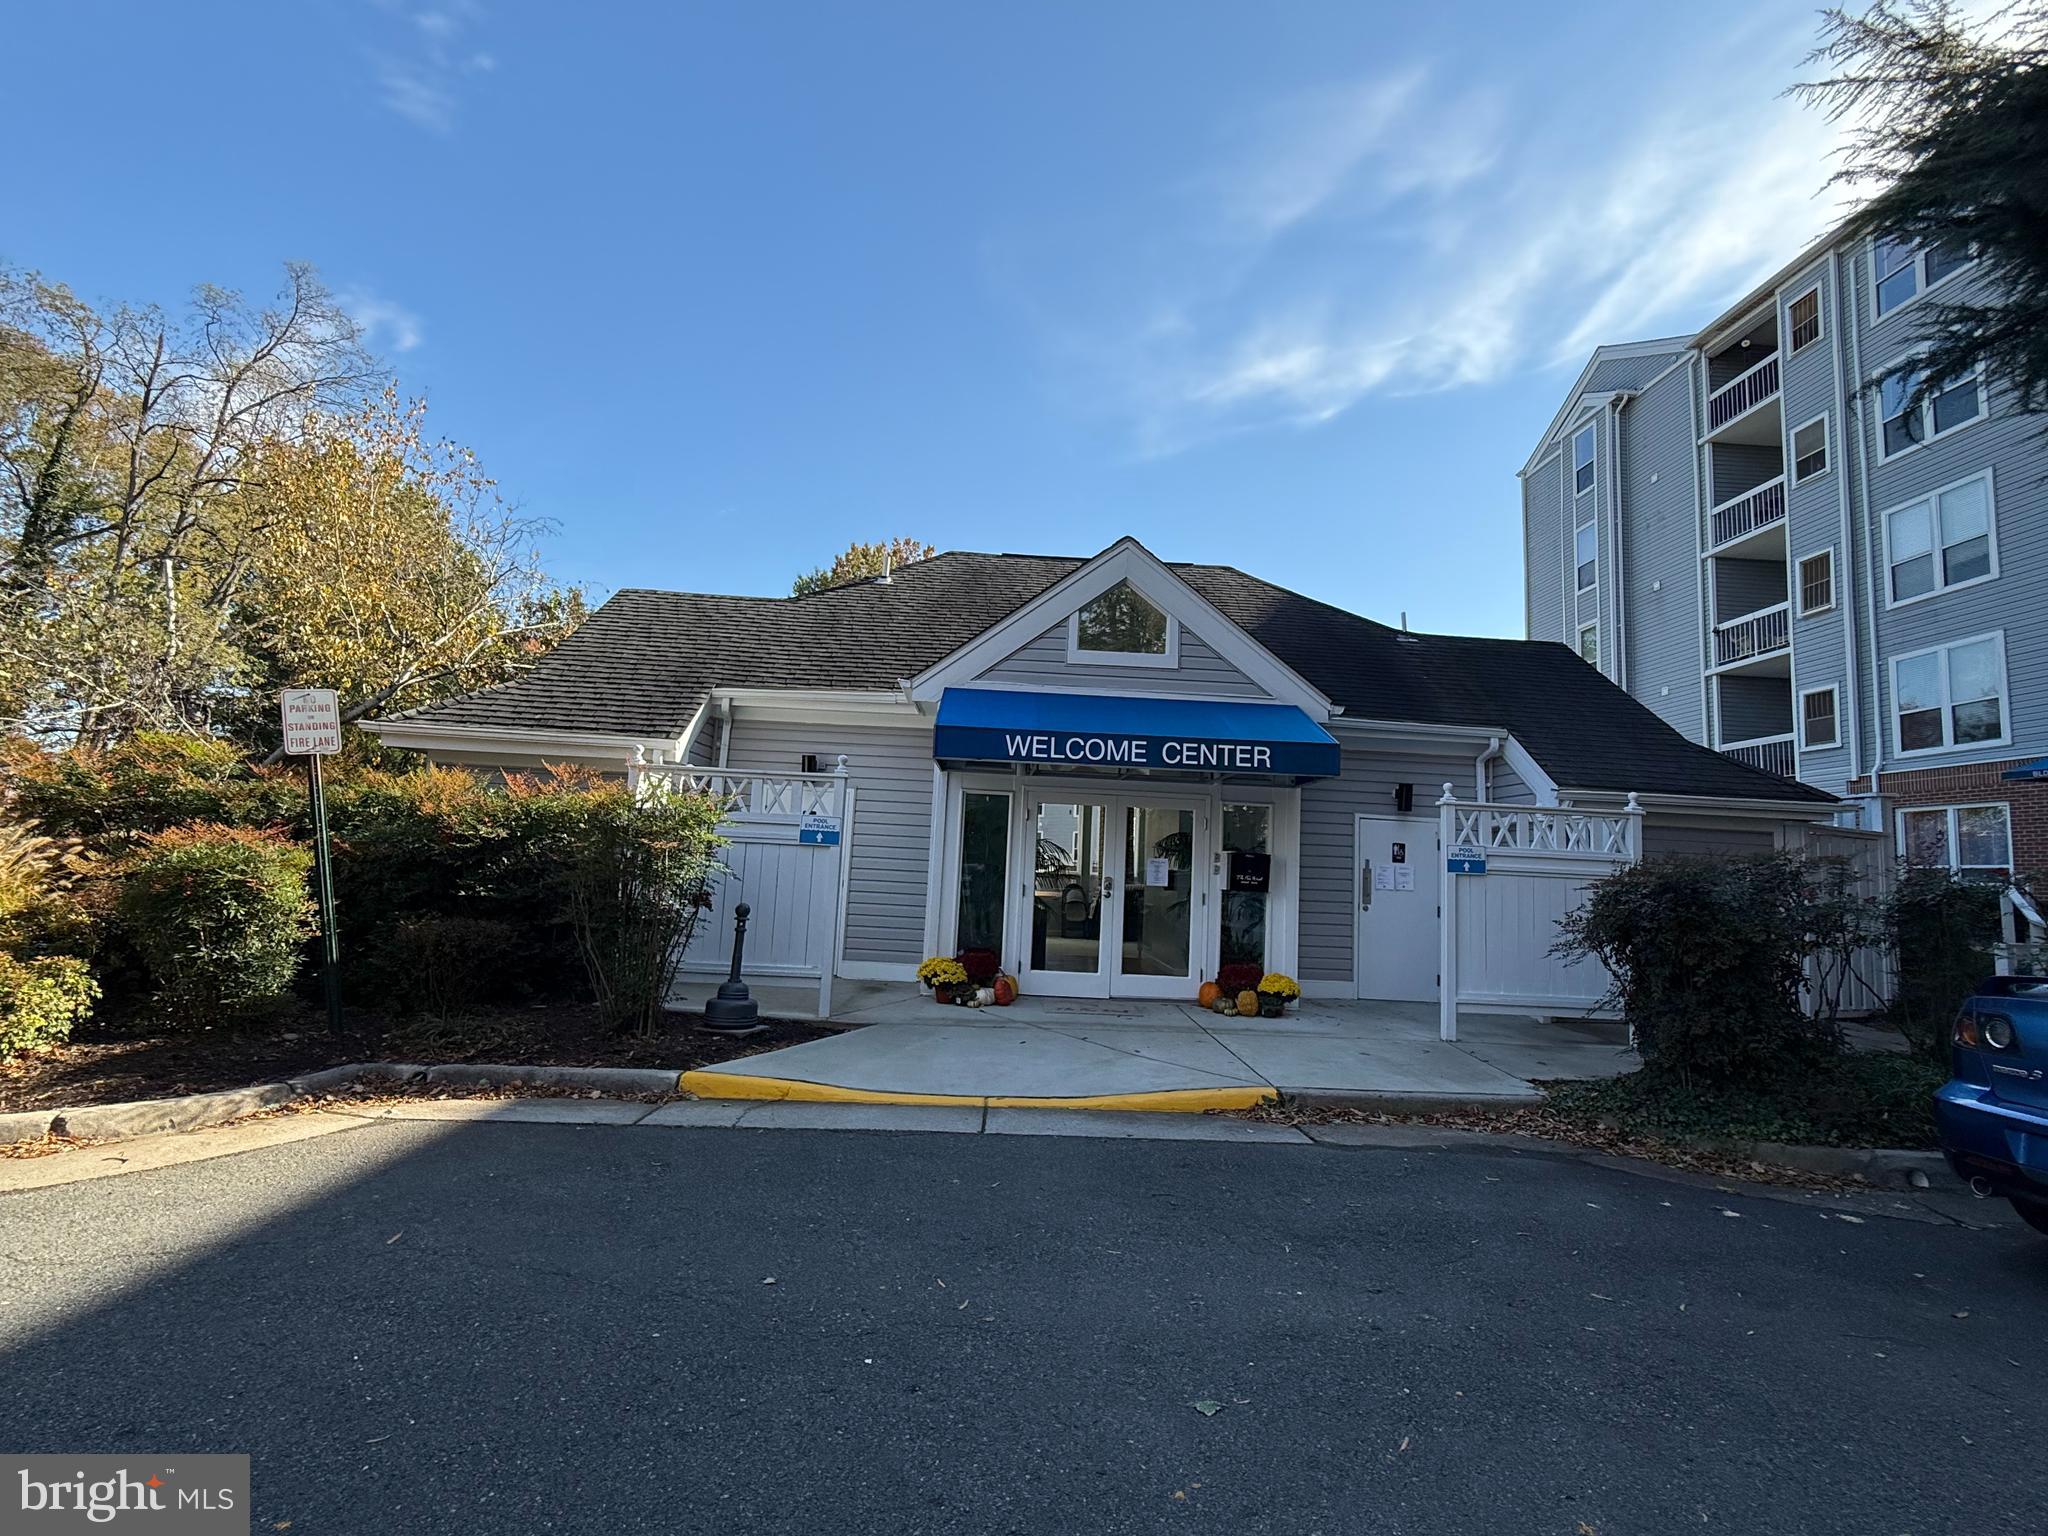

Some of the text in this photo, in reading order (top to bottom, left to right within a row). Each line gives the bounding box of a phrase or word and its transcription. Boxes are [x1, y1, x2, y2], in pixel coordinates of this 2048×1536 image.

[289, 704, 331, 713] PARKING
[288, 721, 336, 731] STANDING
[290, 736, 336, 747] FIRE LANE
[1005, 734, 1272, 768] WELCOME CENTER
